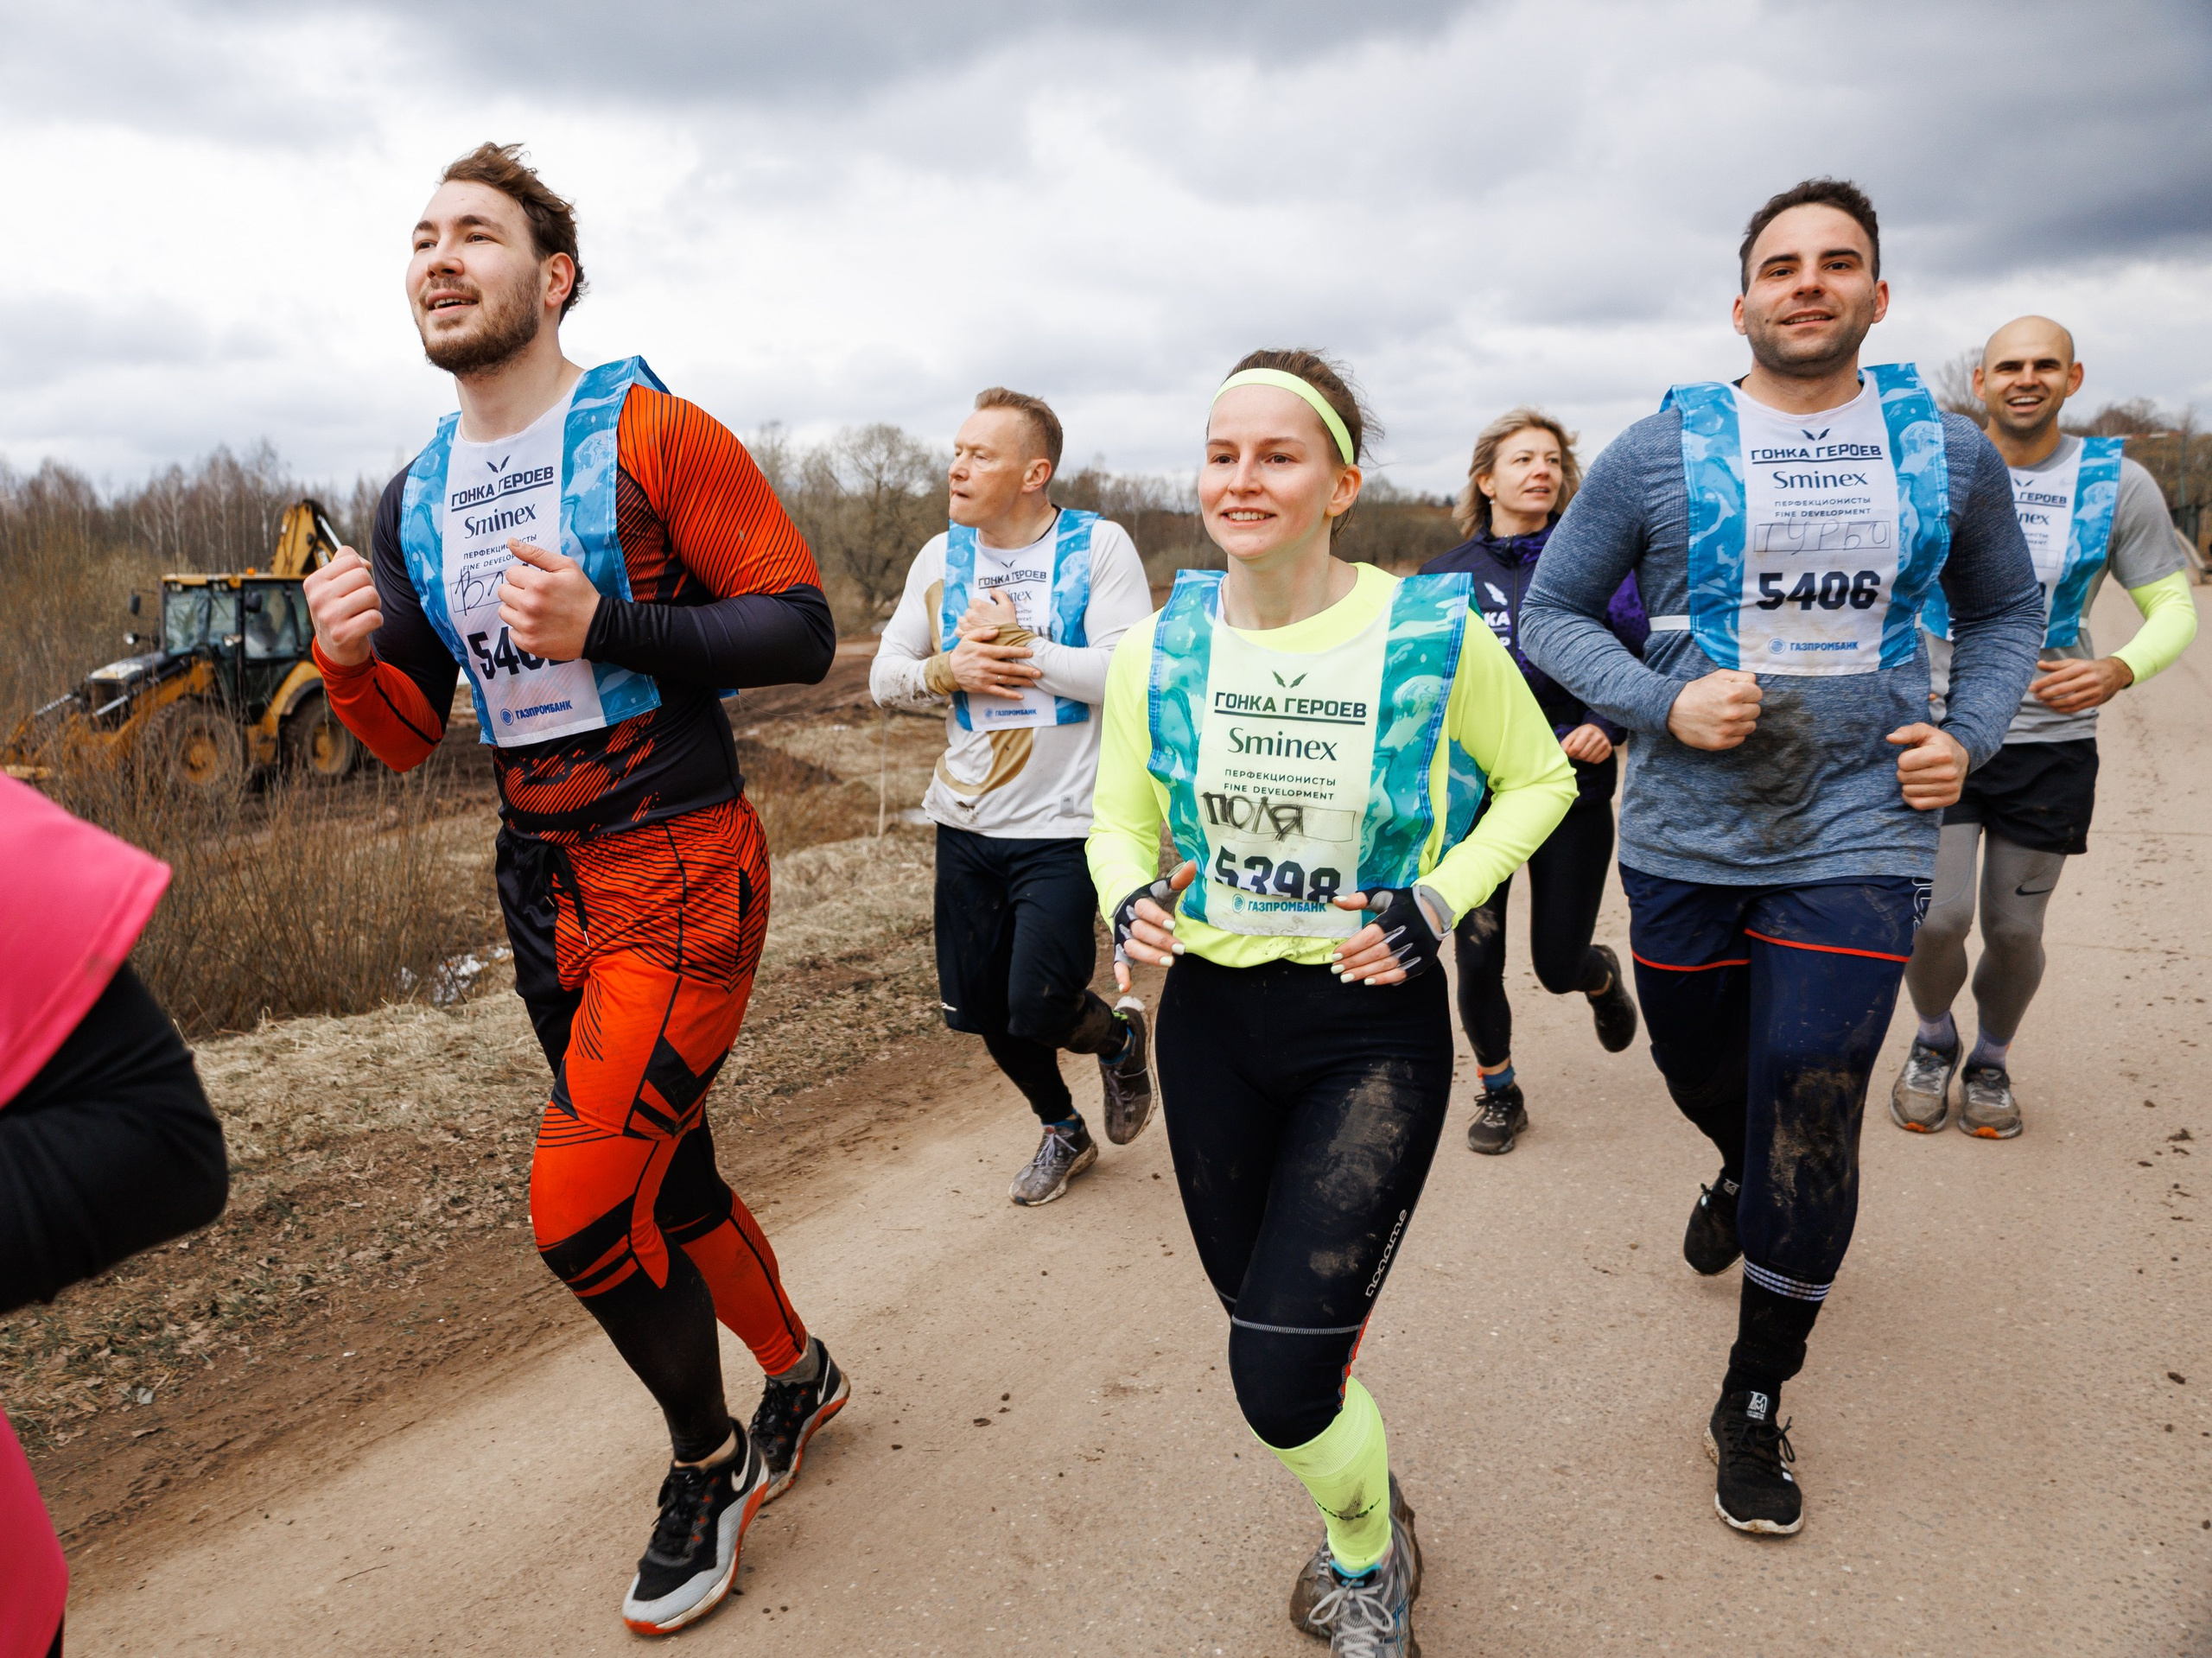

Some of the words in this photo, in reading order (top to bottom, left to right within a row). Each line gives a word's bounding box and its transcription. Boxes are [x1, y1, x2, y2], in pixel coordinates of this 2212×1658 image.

[1751, 448, 1810, 461] ГОНКА
[1815, 443, 1883, 459] ГЕРОЕВ
[451, 484, 495, 507] ГОНКА
[498, 466, 554, 492] ГЕРОЕВ
[1772, 470, 1869, 490] Sminex
[1774, 497, 1872, 508] ПЕРФЕКЦИОНИСТЫ
[2019, 492, 2067, 504] ГЕРОЕВ
[464, 503, 537, 539] Sminex
[1800, 508, 1872, 518] DEVELOPMENT
[1754, 517, 1889, 556] ТУРБО
[462, 562, 480, 572] FINE
[483, 553, 517, 568] DEVELOP
[978, 575, 1010, 587] ГОНКА
[1012, 569, 1047, 581] ГЕРОЕВ
[1756, 570, 1882, 611] 5406
[1789, 641, 1859, 652] ГАЗПРОМБАНК
[514, 700, 574, 721] ГАЗПРОМБАНК
[1214, 691, 1275, 713] ГОНКА
[1284, 697, 1367, 719] ГЕРОЕВ
[1227, 727, 1338, 761] Sminex
[1224, 768, 1337, 786] ПЕРФЕКЦИОНИСТЫ
[1224, 783, 1248, 793] FINE
[1253, 786, 1335, 801] DEVELOPMENT
[1200, 791, 1304, 842] ПОЛЯ
[1214, 845, 1342, 904] 5398
[1247, 899, 1328, 913] ГАЗПРОМБАНК
[1365, 1209, 1408, 1298] noname
